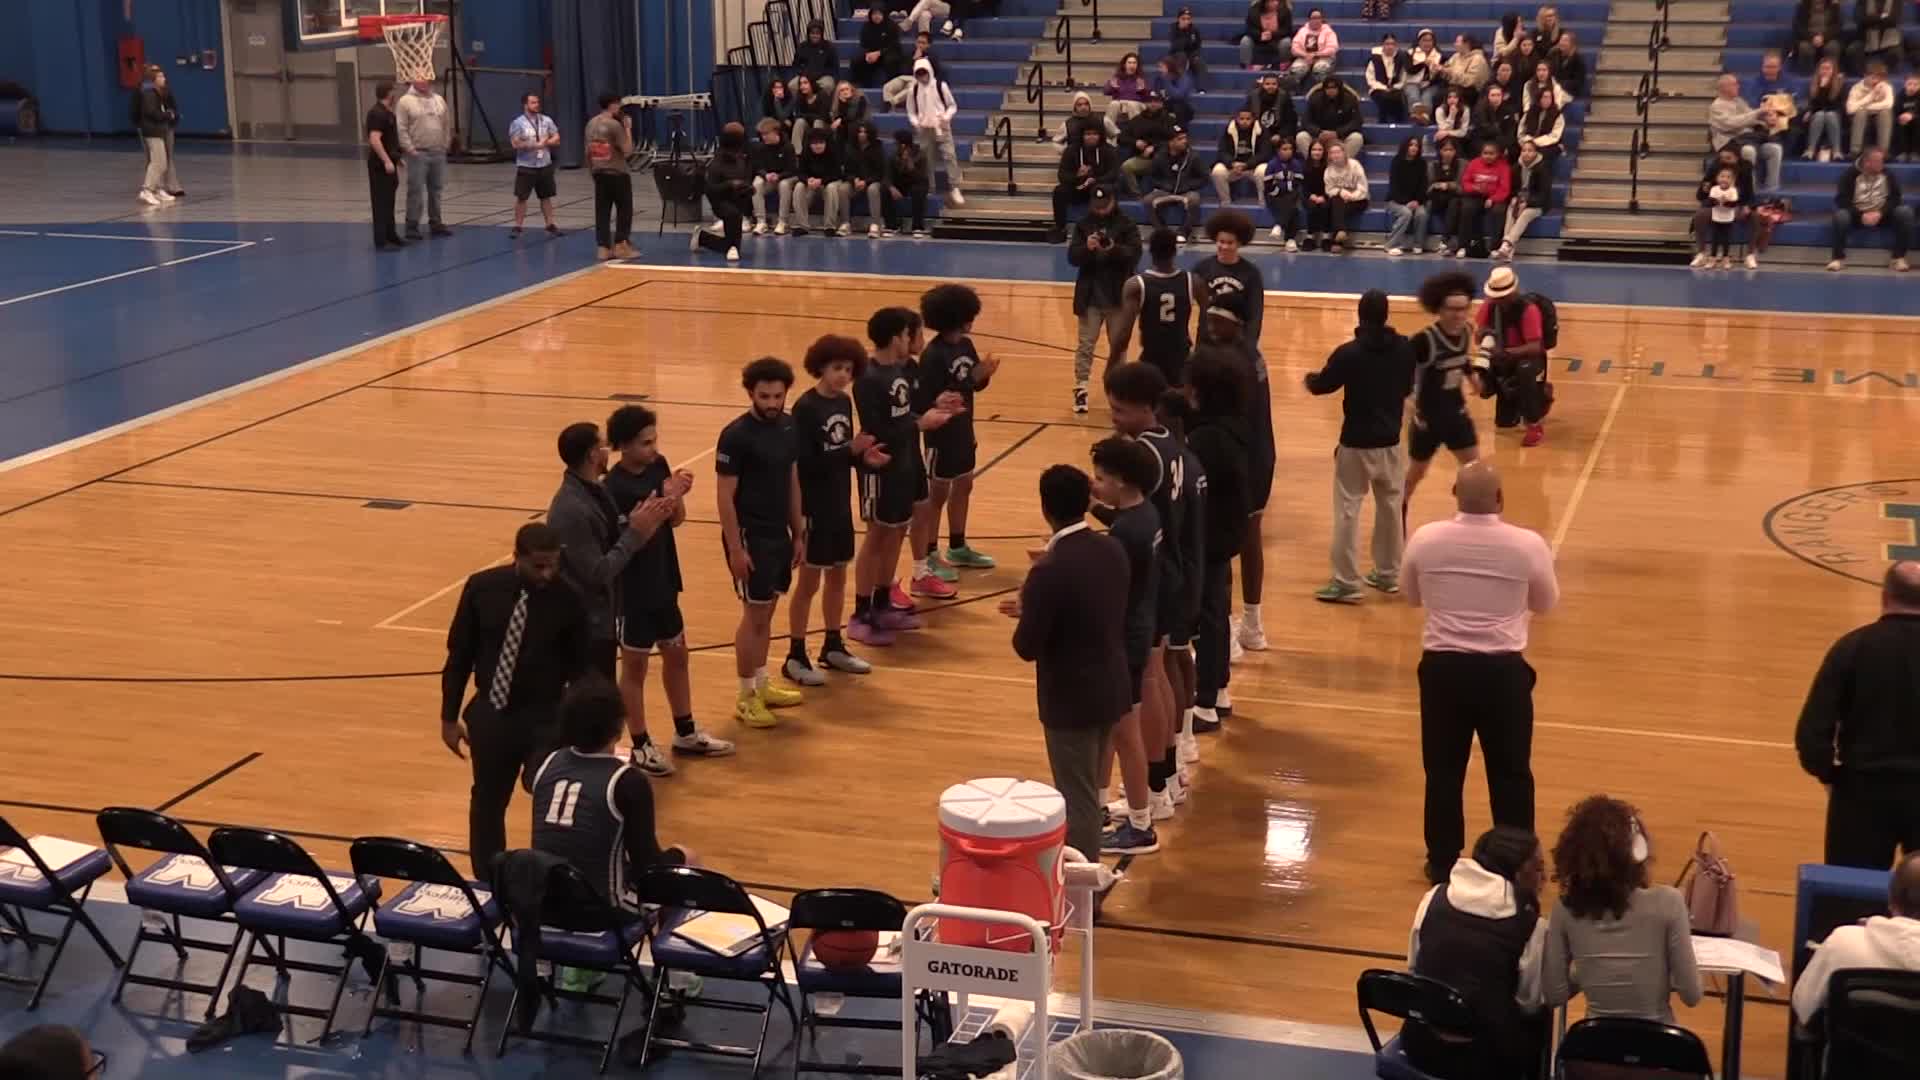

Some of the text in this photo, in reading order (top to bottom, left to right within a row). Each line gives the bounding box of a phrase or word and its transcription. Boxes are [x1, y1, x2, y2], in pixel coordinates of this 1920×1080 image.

[1159, 292, 1177, 323] 2
[1169, 455, 1184, 501] 34
[1781, 485, 1910, 565] RANGERS
[544, 779, 583, 827] 11
[927, 960, 1019, 983] GATORADE
